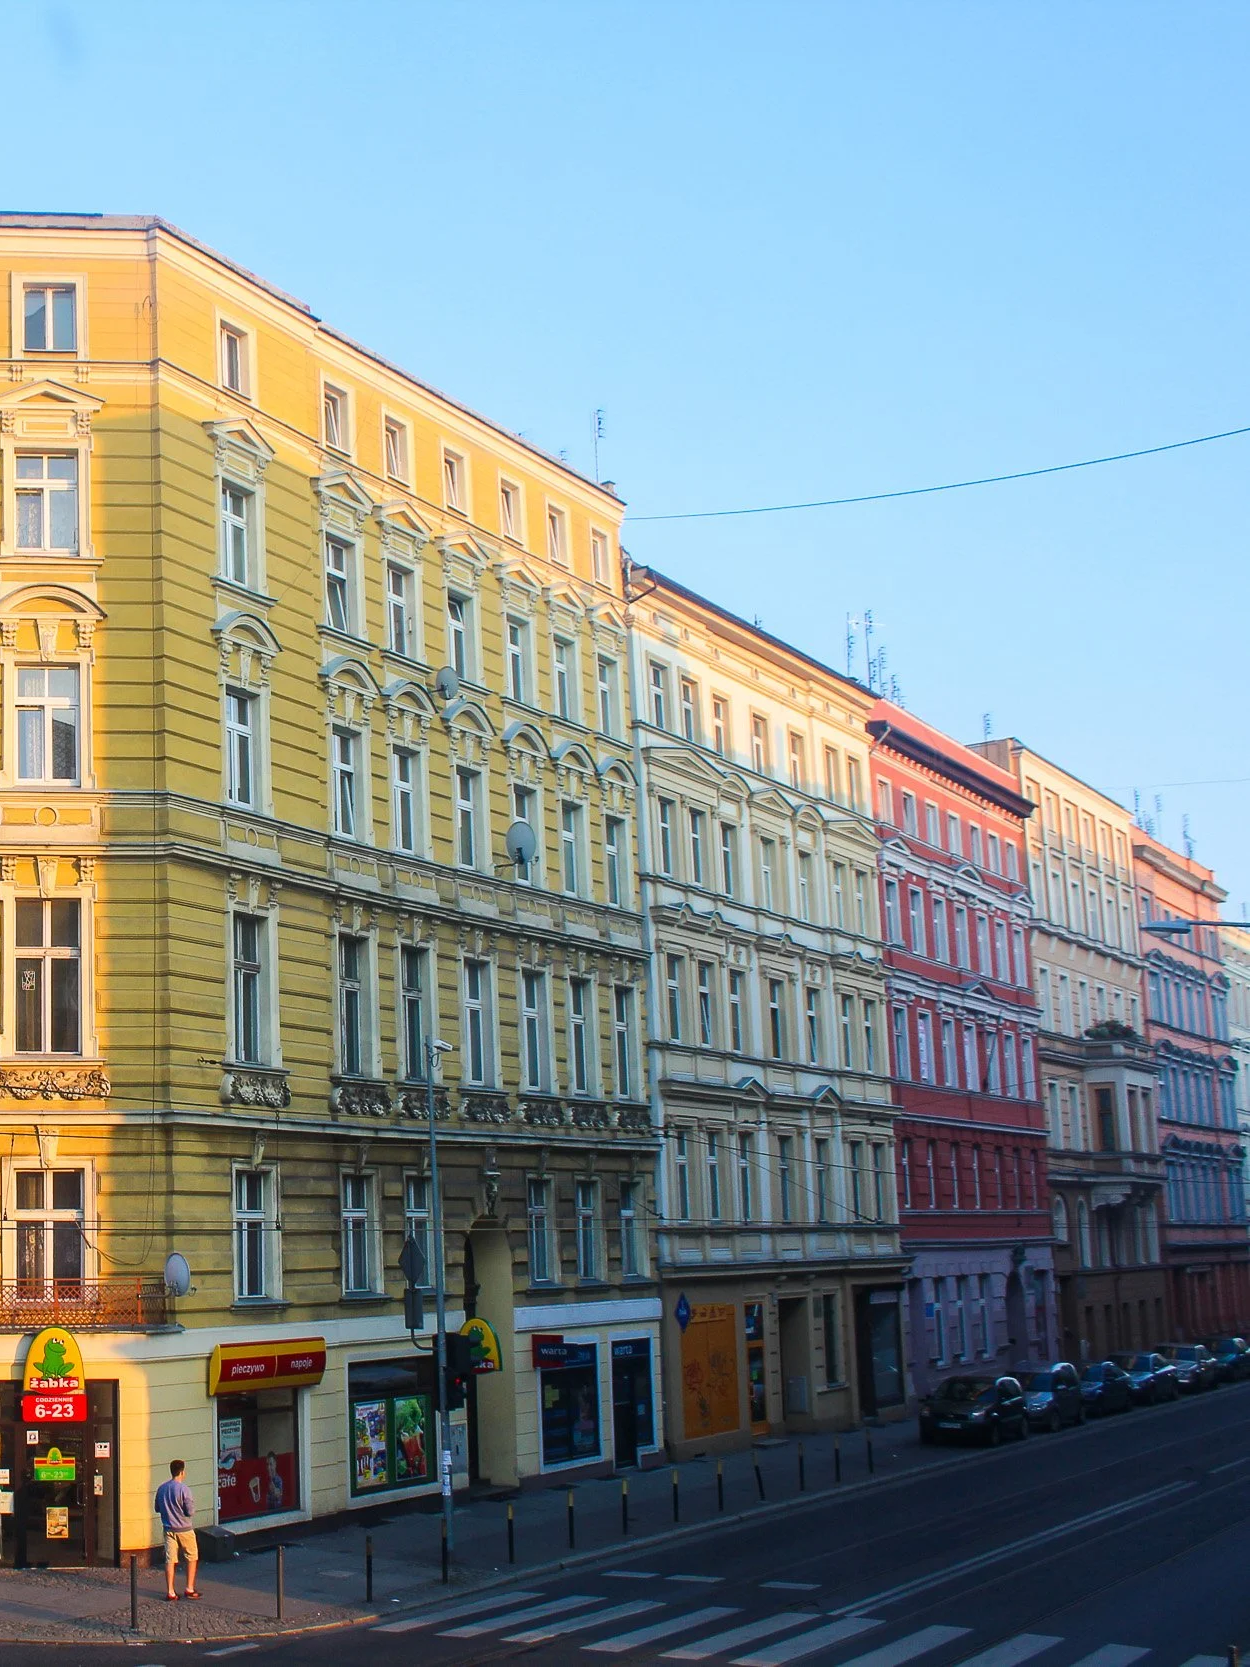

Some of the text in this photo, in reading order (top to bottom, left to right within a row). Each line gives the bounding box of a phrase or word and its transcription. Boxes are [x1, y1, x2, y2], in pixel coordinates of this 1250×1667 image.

[540, 1346, 568, 1355] warta
[231, 1363, 265, 1377] pieczywo
[290, 1357, 313, 1370] napoje
[30, 1378, 79, 1388] żabka
[35, 1403, 74, 1418] 6-23
